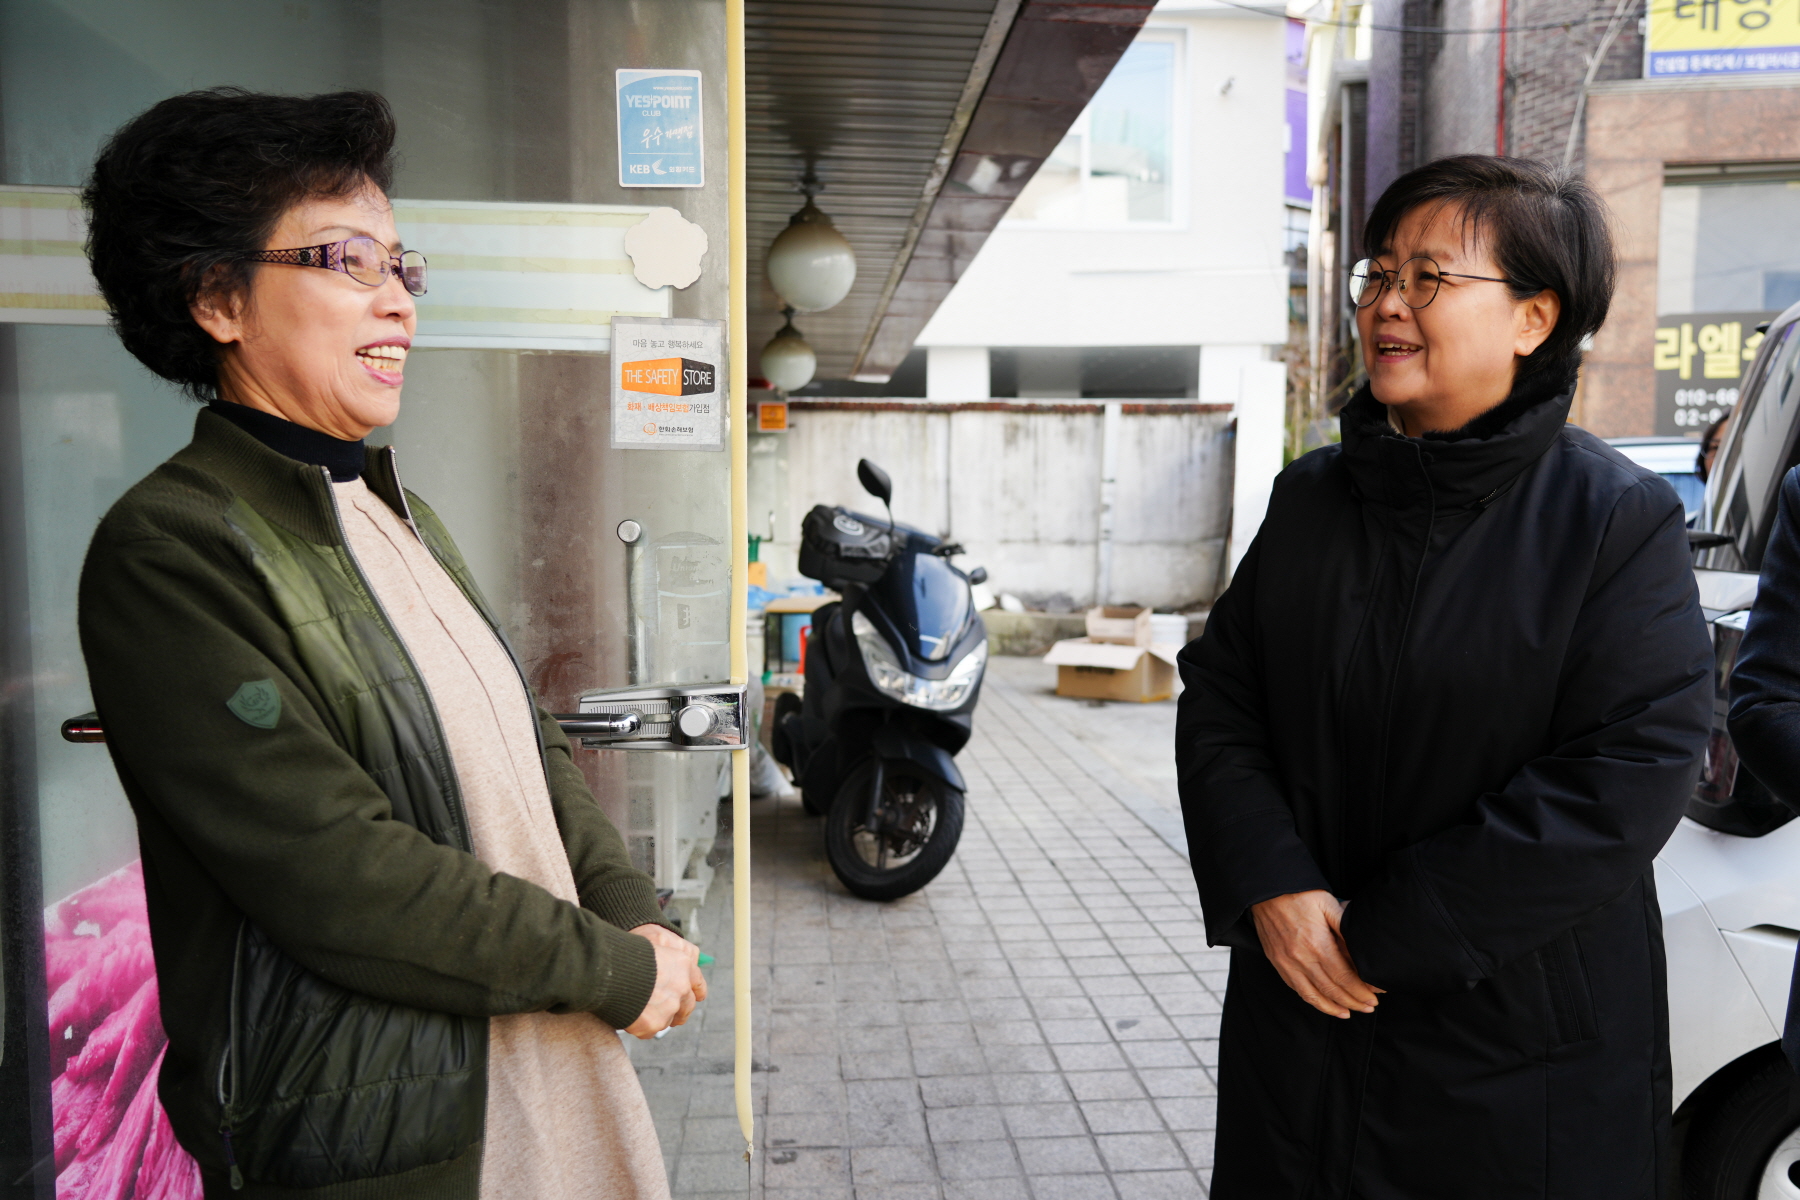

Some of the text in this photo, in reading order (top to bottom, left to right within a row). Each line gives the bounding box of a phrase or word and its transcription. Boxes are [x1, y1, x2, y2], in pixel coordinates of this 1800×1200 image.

[641, 126, 663, 149] 우수
[629, 164, 651, 175] KEB
[632, 338, 704, 350] 마음 놓고 행복하세요
[625, 368, 712, 386] THE SAFETY STORE
[627, 402, 642, 412] 화재
